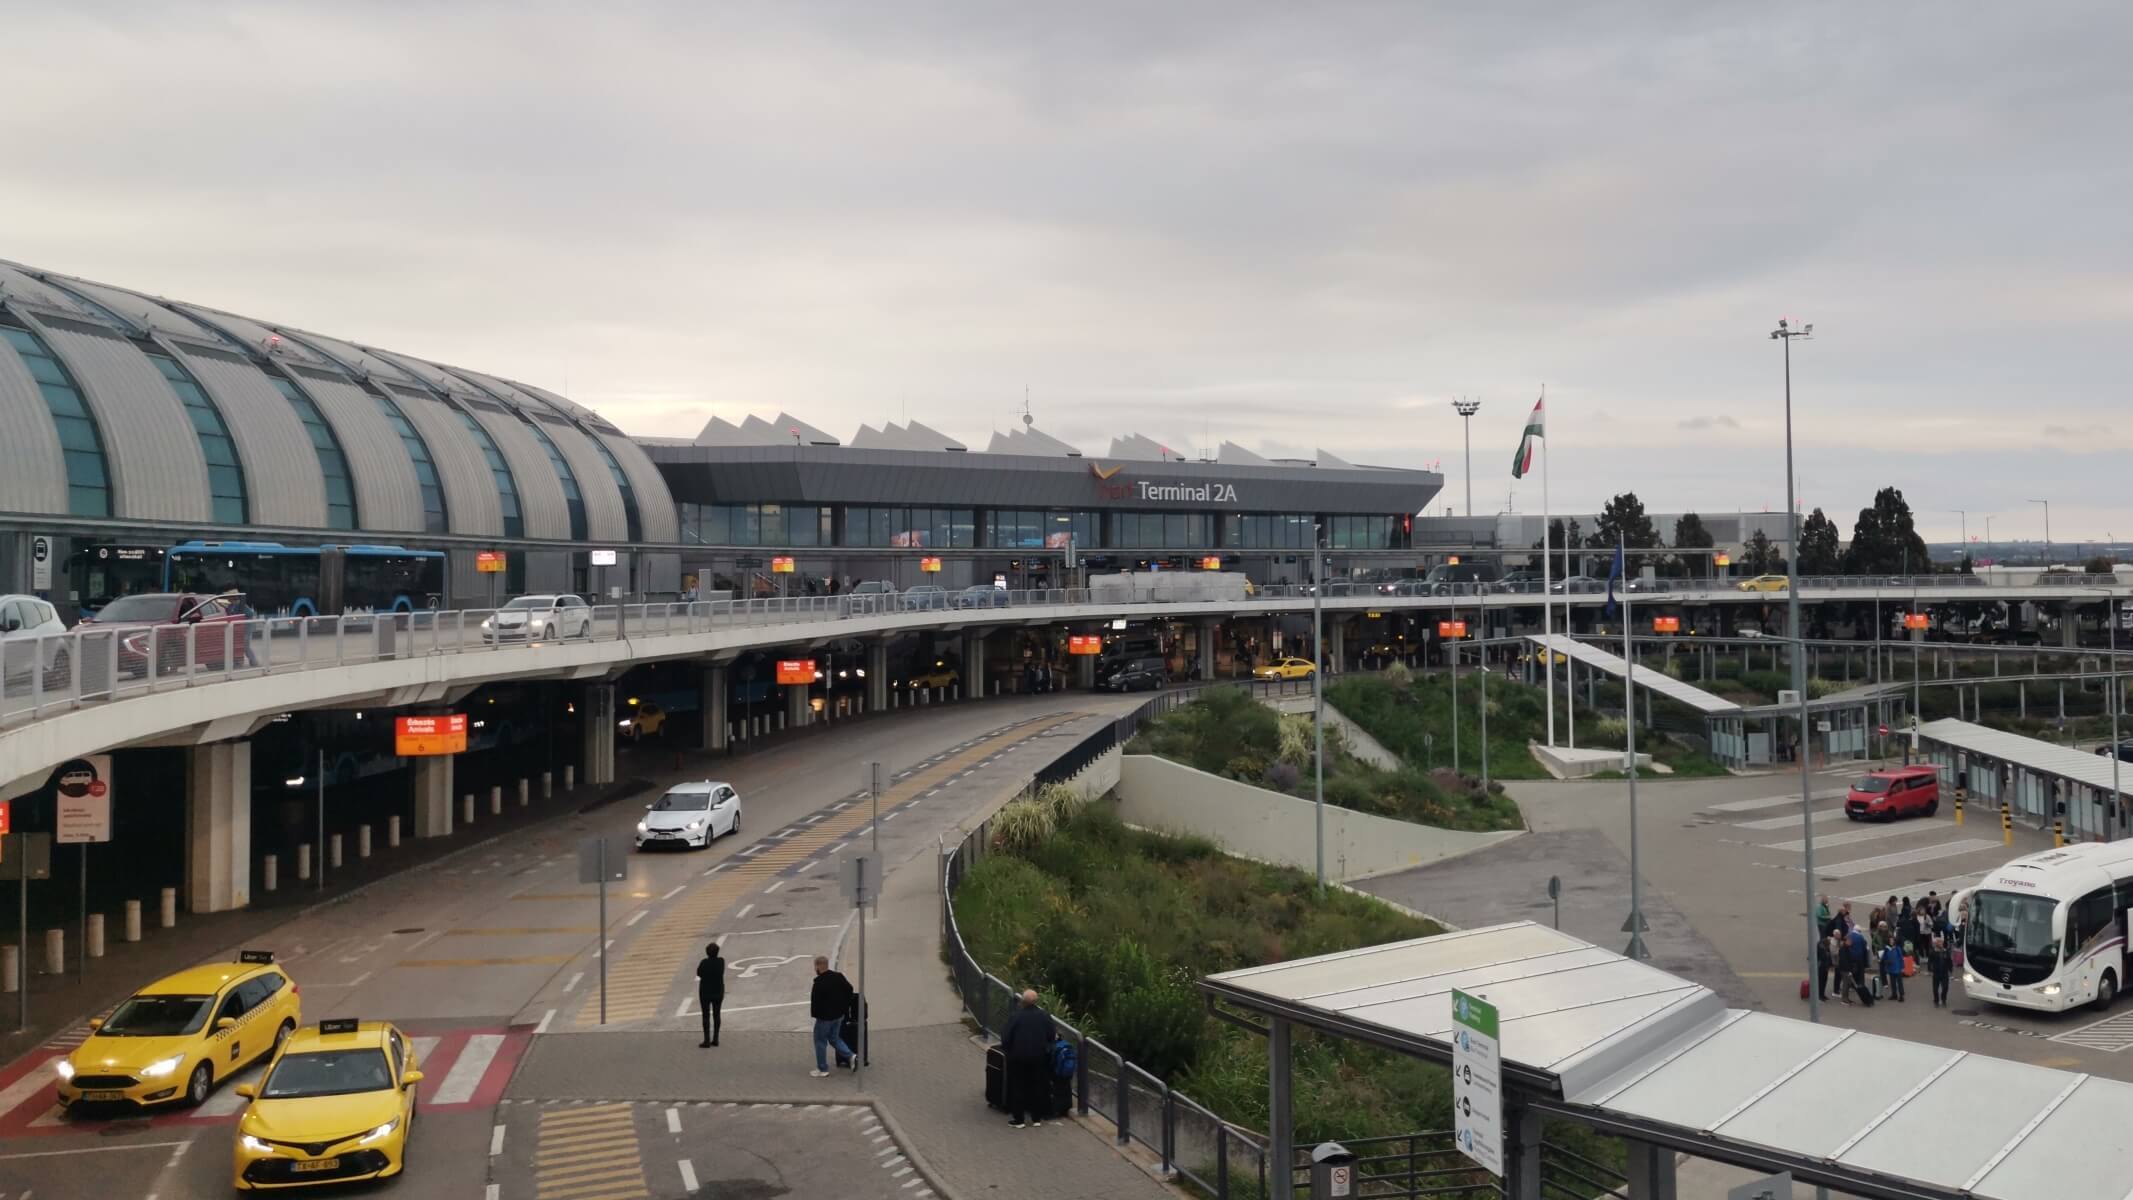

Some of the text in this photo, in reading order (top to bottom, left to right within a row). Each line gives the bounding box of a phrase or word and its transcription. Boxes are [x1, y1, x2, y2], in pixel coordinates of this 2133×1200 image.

[1138, 481, 1238, 502] Terminal 2A
[324, 1023, 341, 1031] Uber
